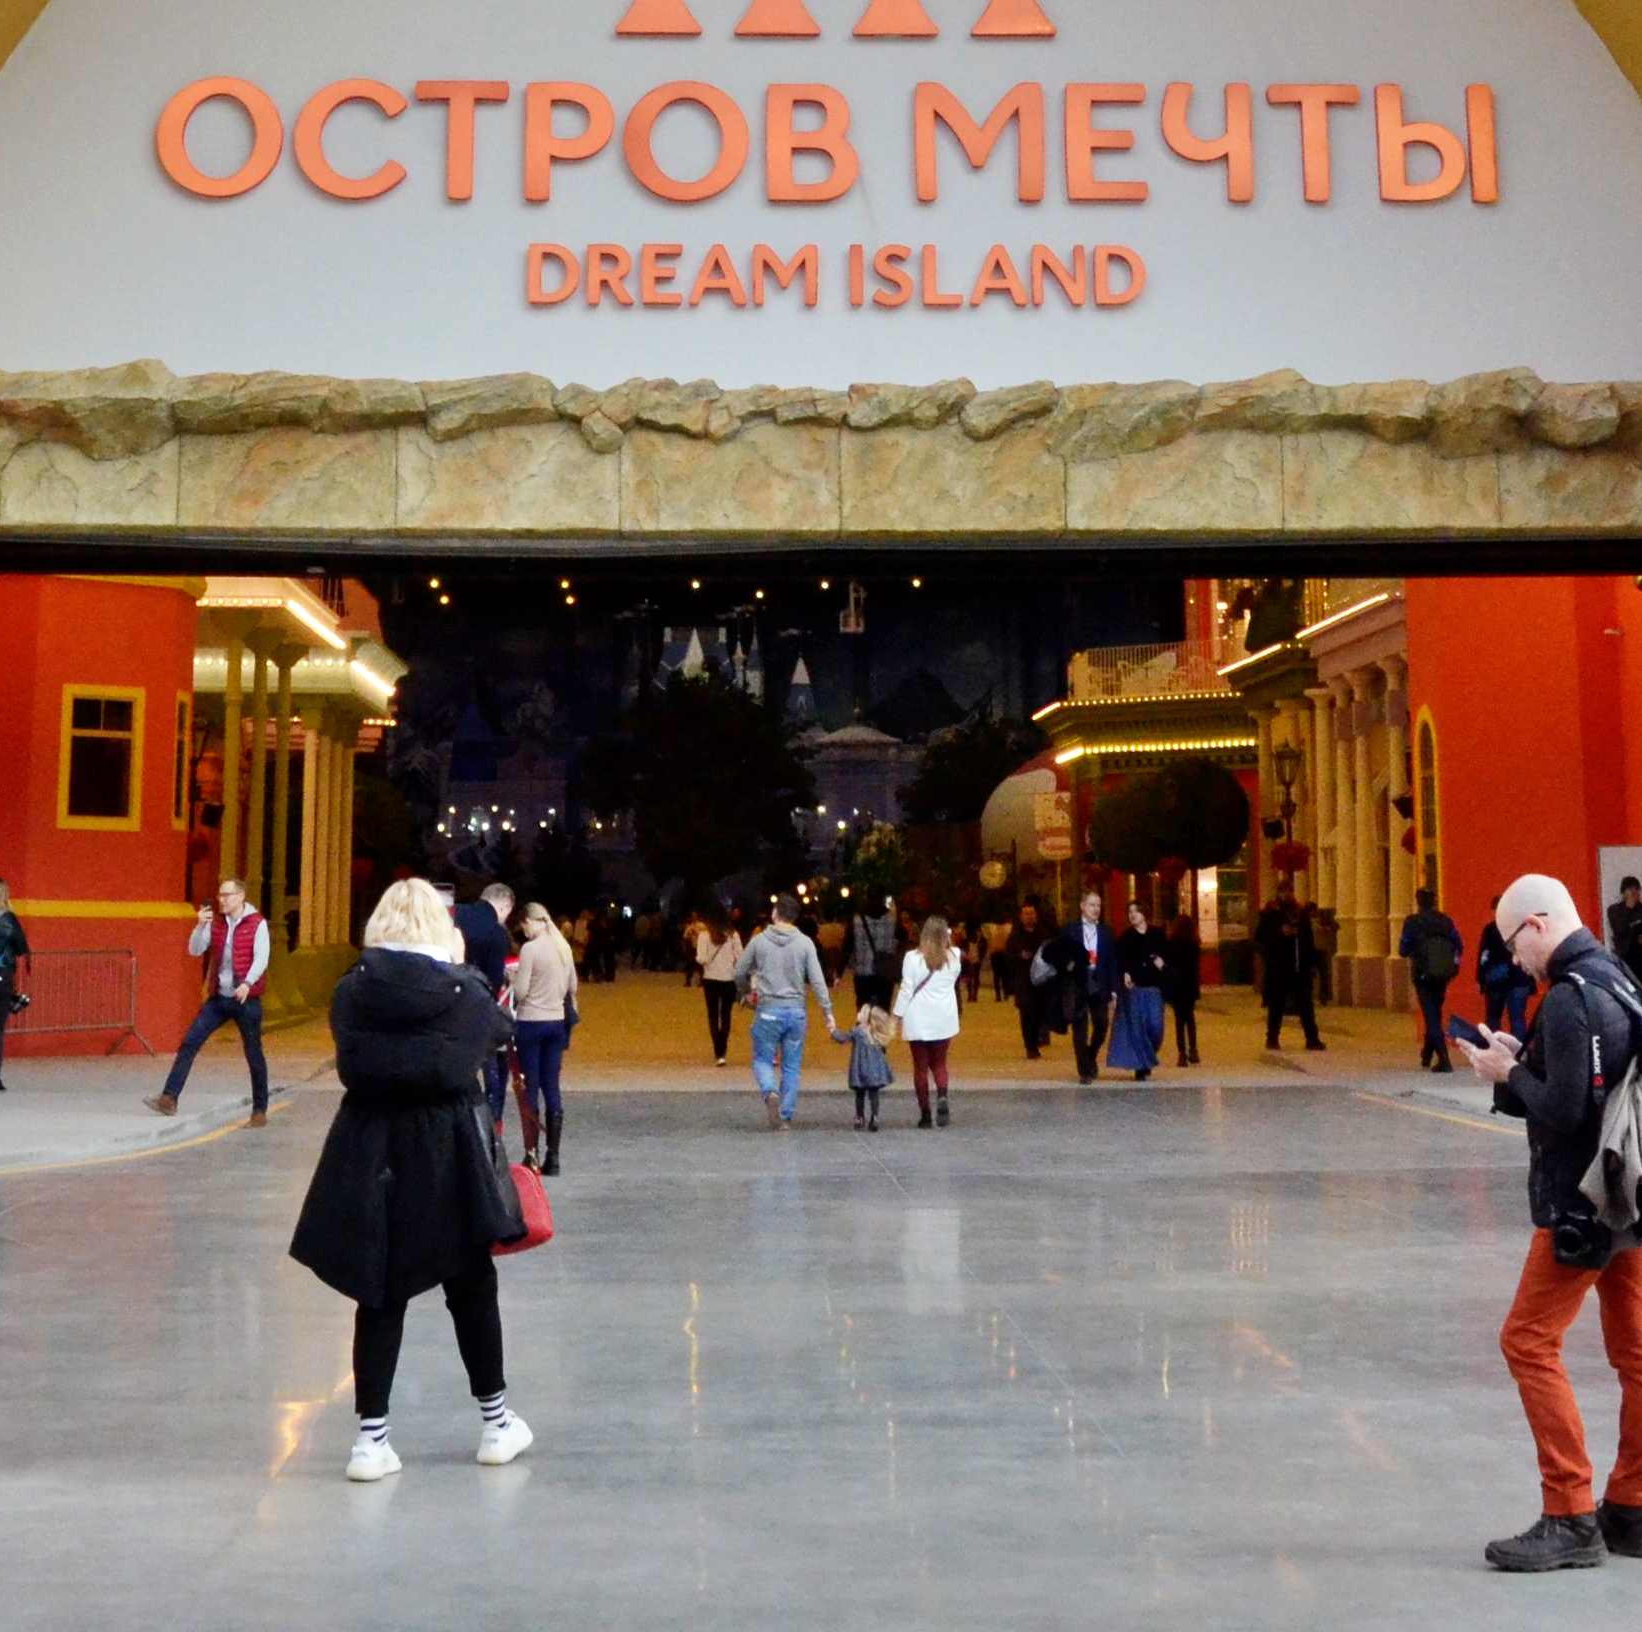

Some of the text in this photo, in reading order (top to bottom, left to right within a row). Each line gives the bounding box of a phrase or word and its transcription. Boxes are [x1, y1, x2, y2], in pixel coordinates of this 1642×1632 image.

[153, 75, 1501, 206] ОСТРОВ МЕЧТЫ
[527, 243, 1147, 309] DREAM ISLAND
[1592, 1035, 1601, 1074] LUMIX
